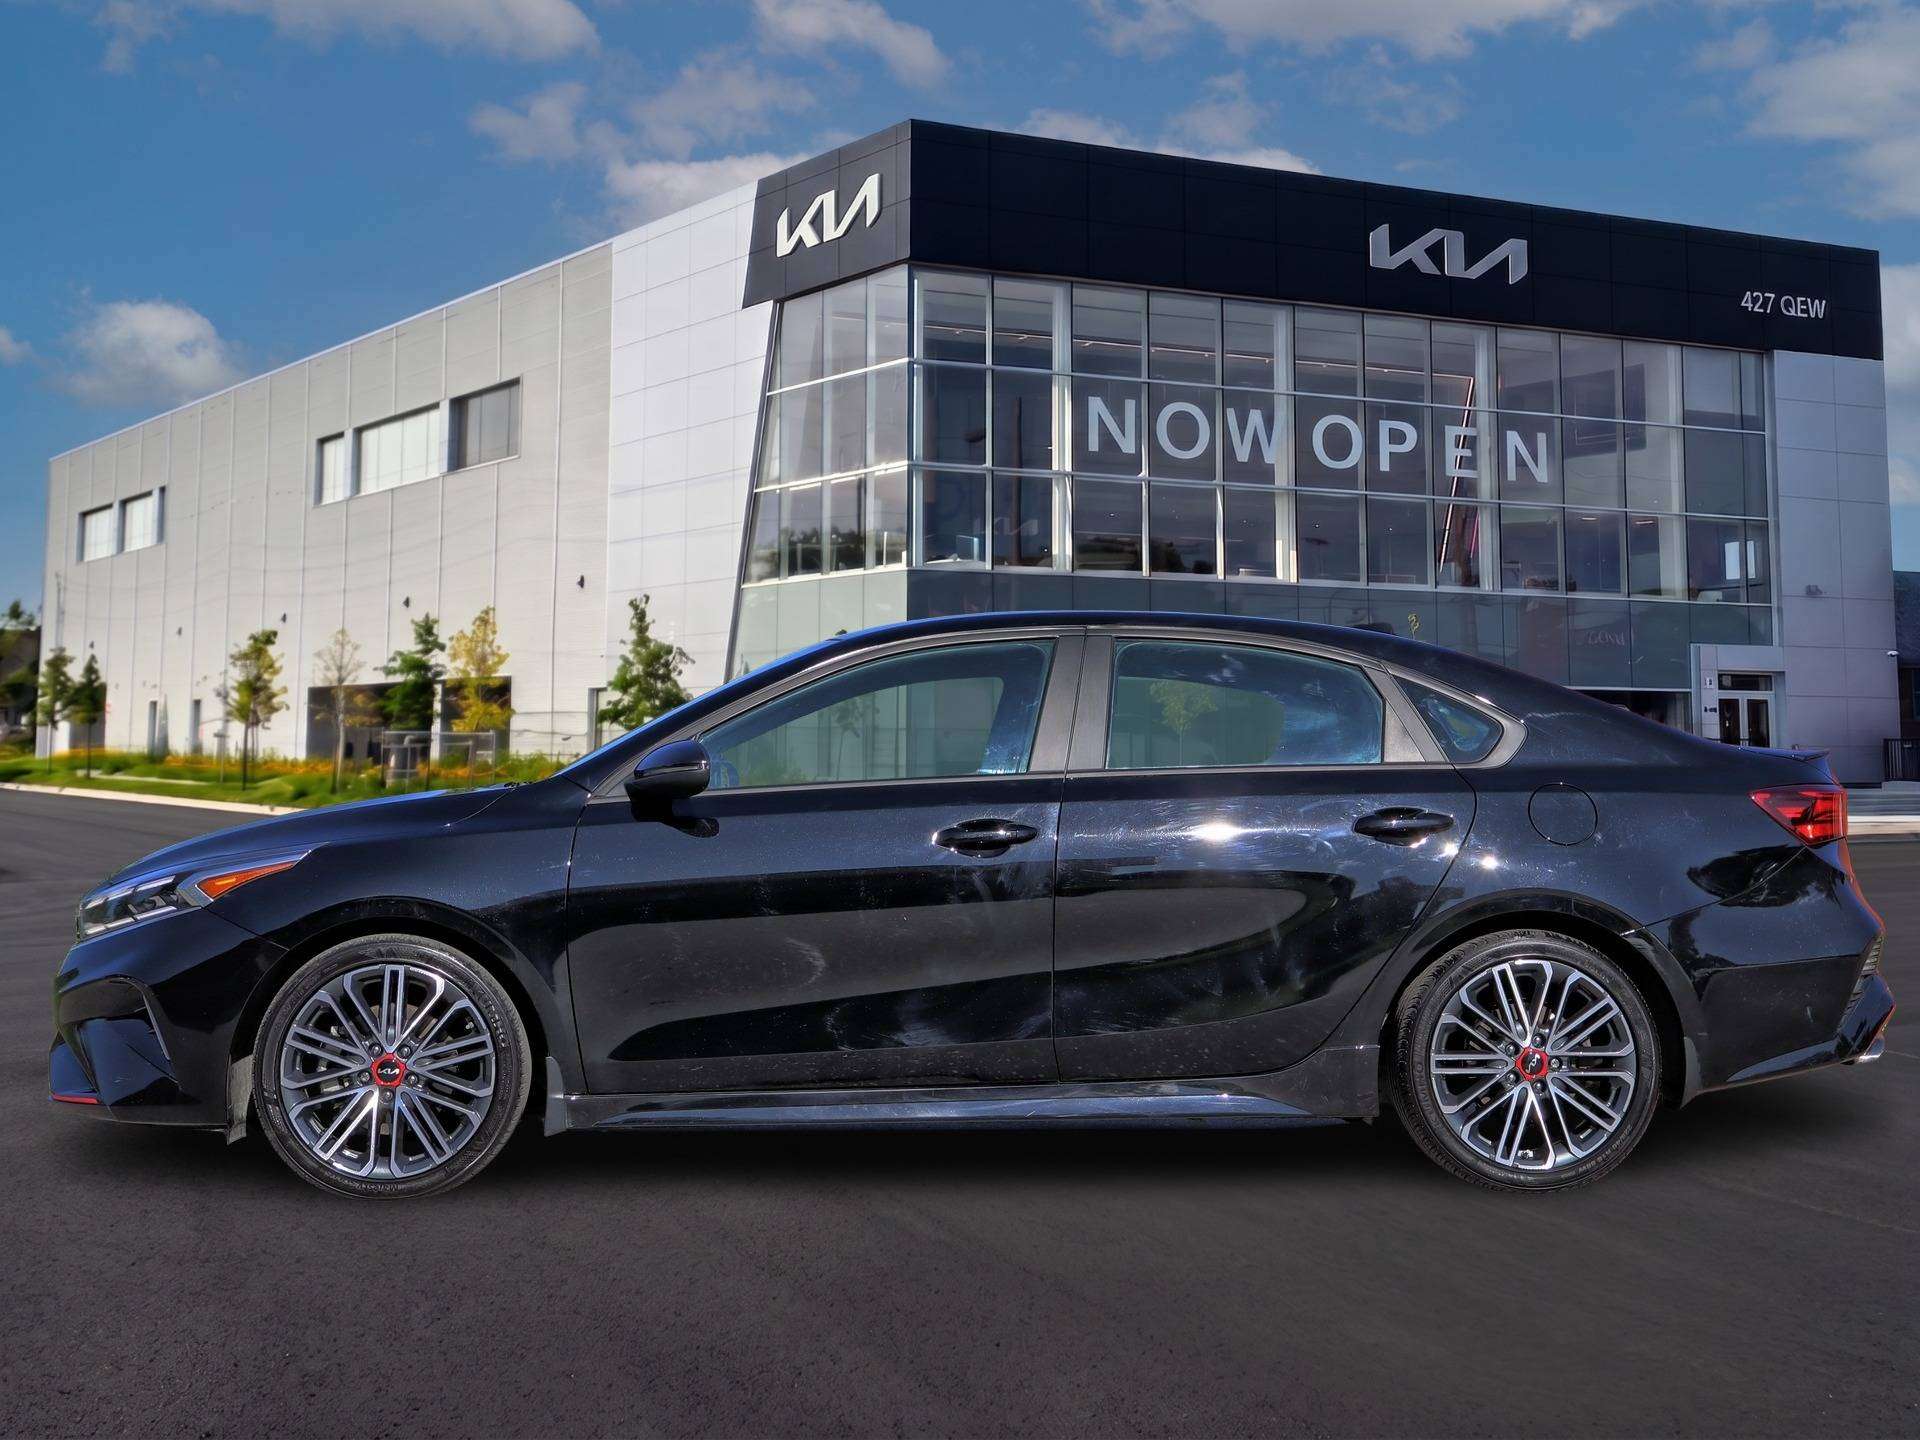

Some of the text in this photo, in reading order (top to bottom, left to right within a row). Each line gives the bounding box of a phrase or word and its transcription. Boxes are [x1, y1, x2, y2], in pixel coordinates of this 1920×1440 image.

[777, 173, 881, 257] KIA
[1370, 223, 1527, 284] KIA
[1741, 291, 1826, 318] 427 QEW
[1088, 396, 1548, 483] NOW OPEN
